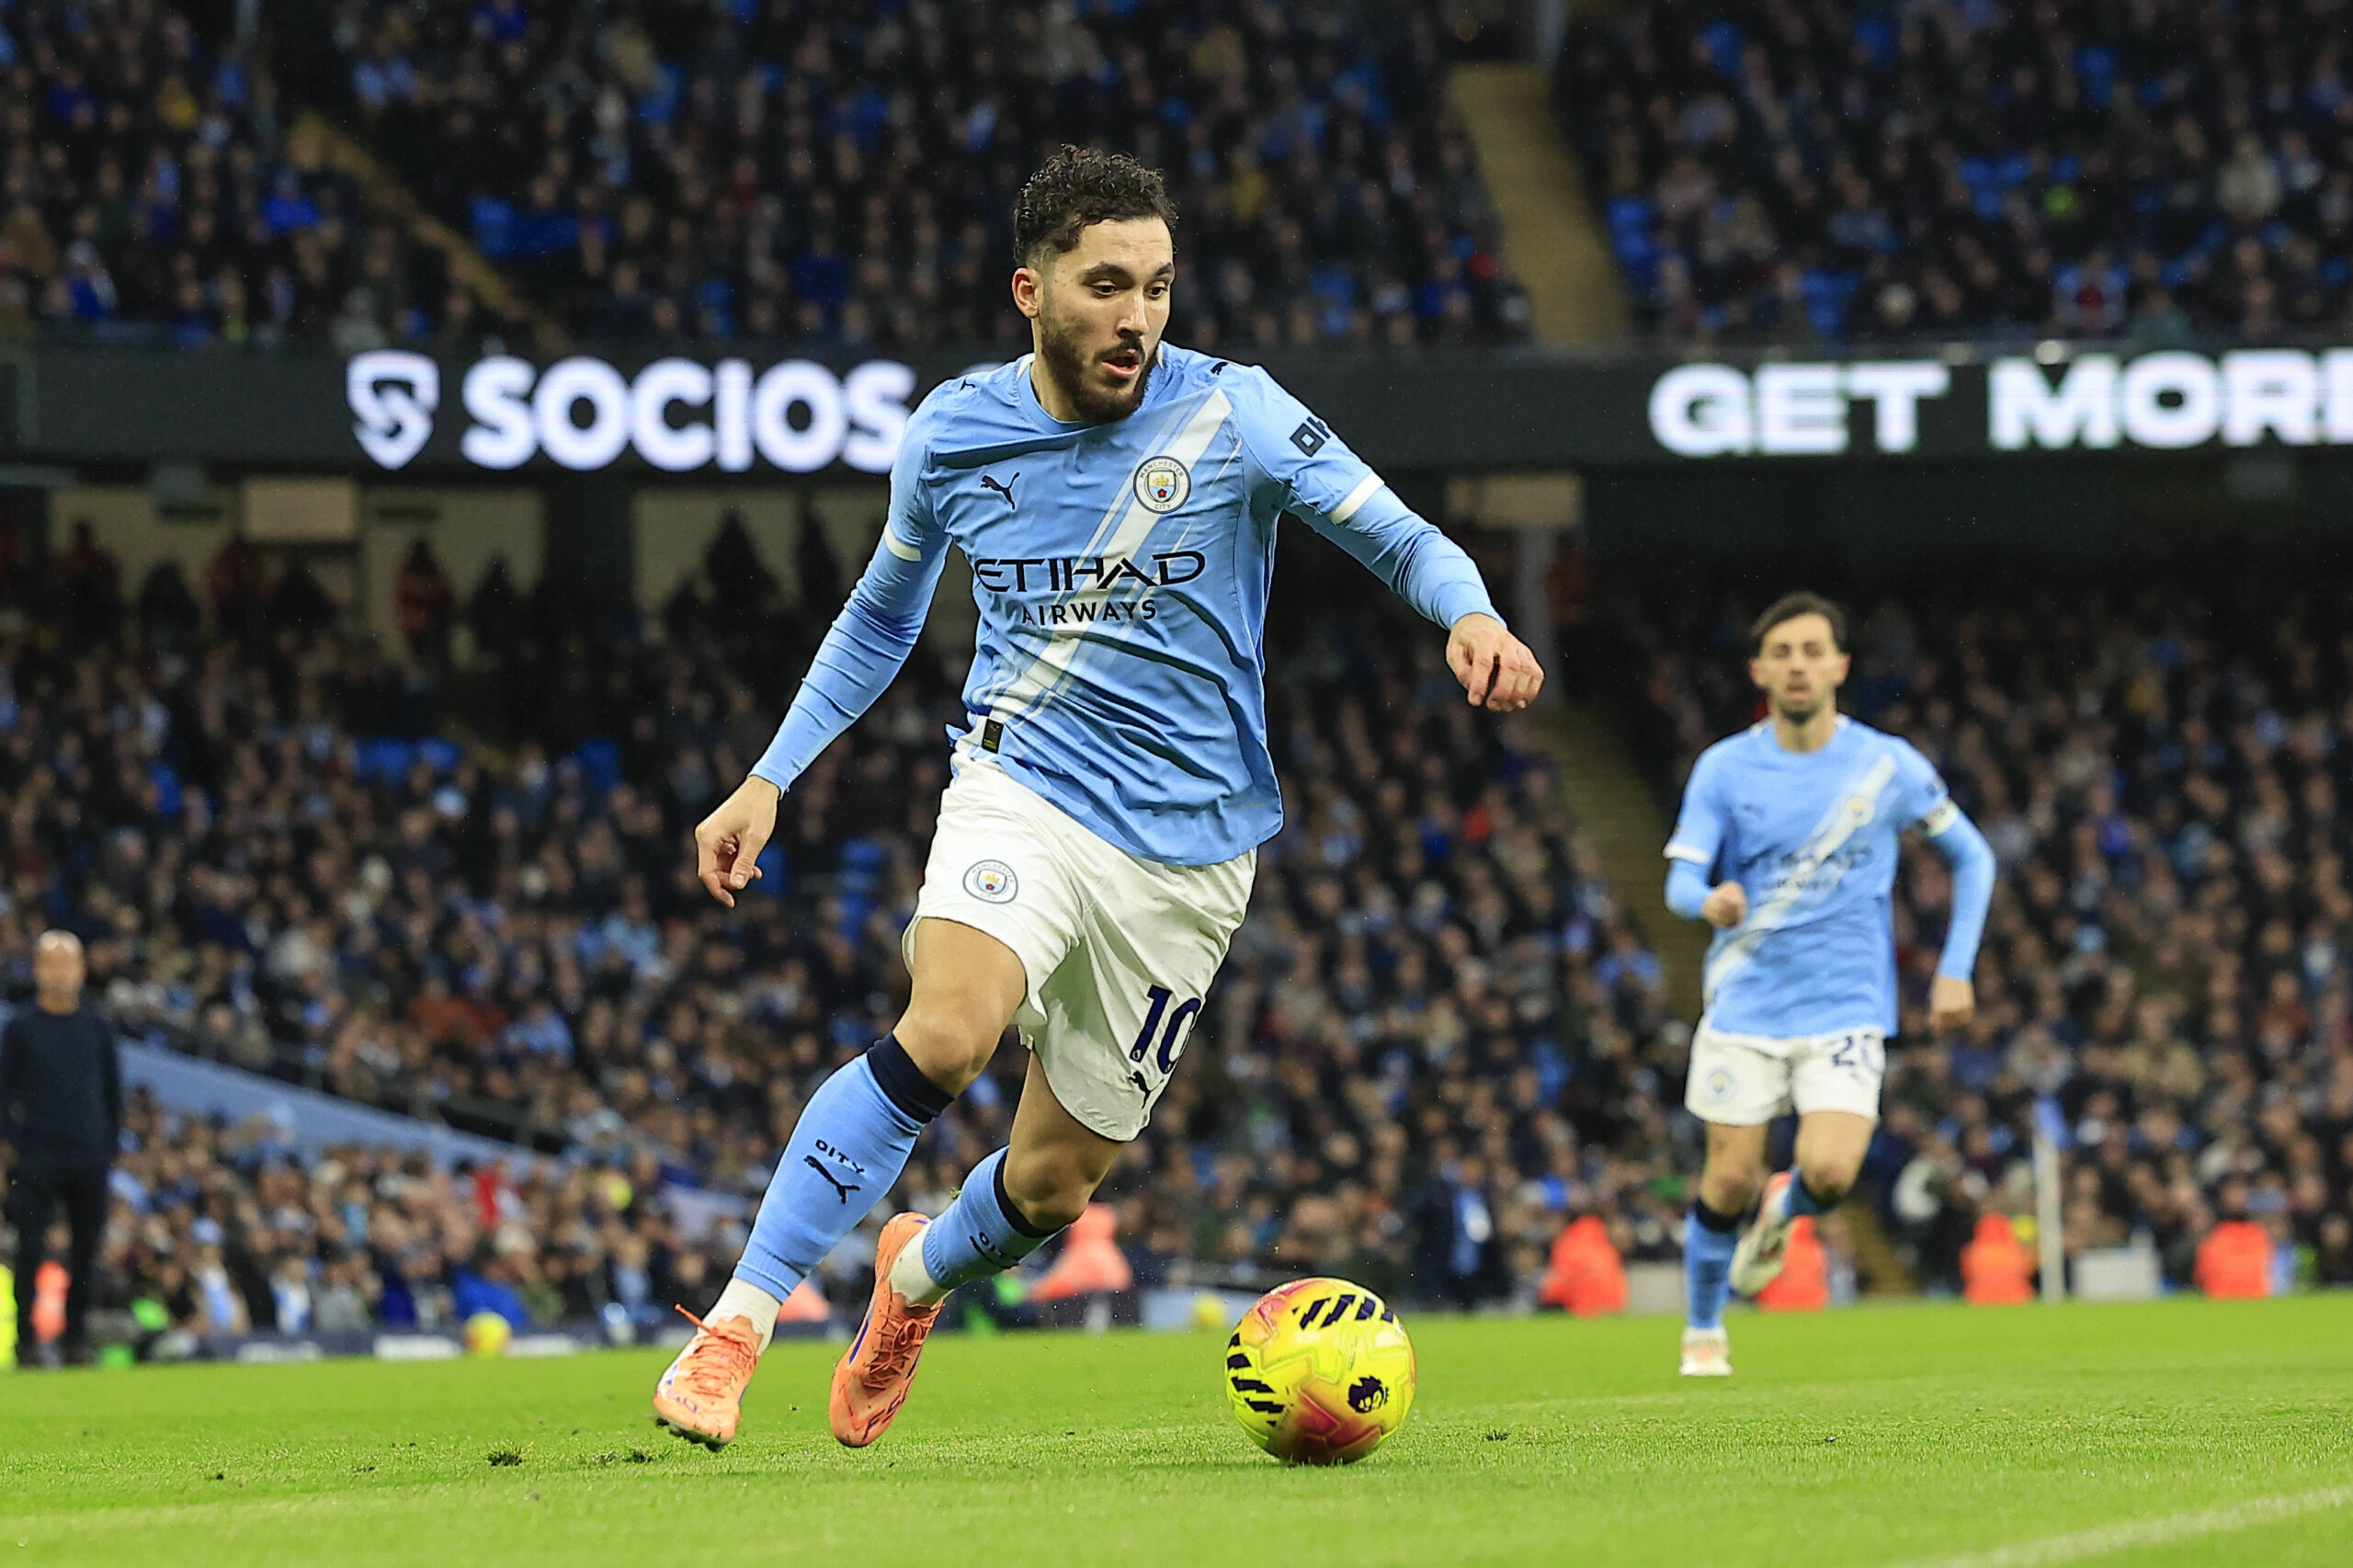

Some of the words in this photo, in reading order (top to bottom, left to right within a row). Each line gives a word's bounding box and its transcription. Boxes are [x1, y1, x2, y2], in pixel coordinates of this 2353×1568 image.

[461, 355, 916, 472] SOCIOS
[1648, 362, 1950, 457] GET
[1140, 460, 1184, 479] MANCHESTER
[974, 551, 1206, 593] ETIHAD
[1021, 599, 1157, 627] AIRWAYS
[1129, 983, 1201, 1074] 10
